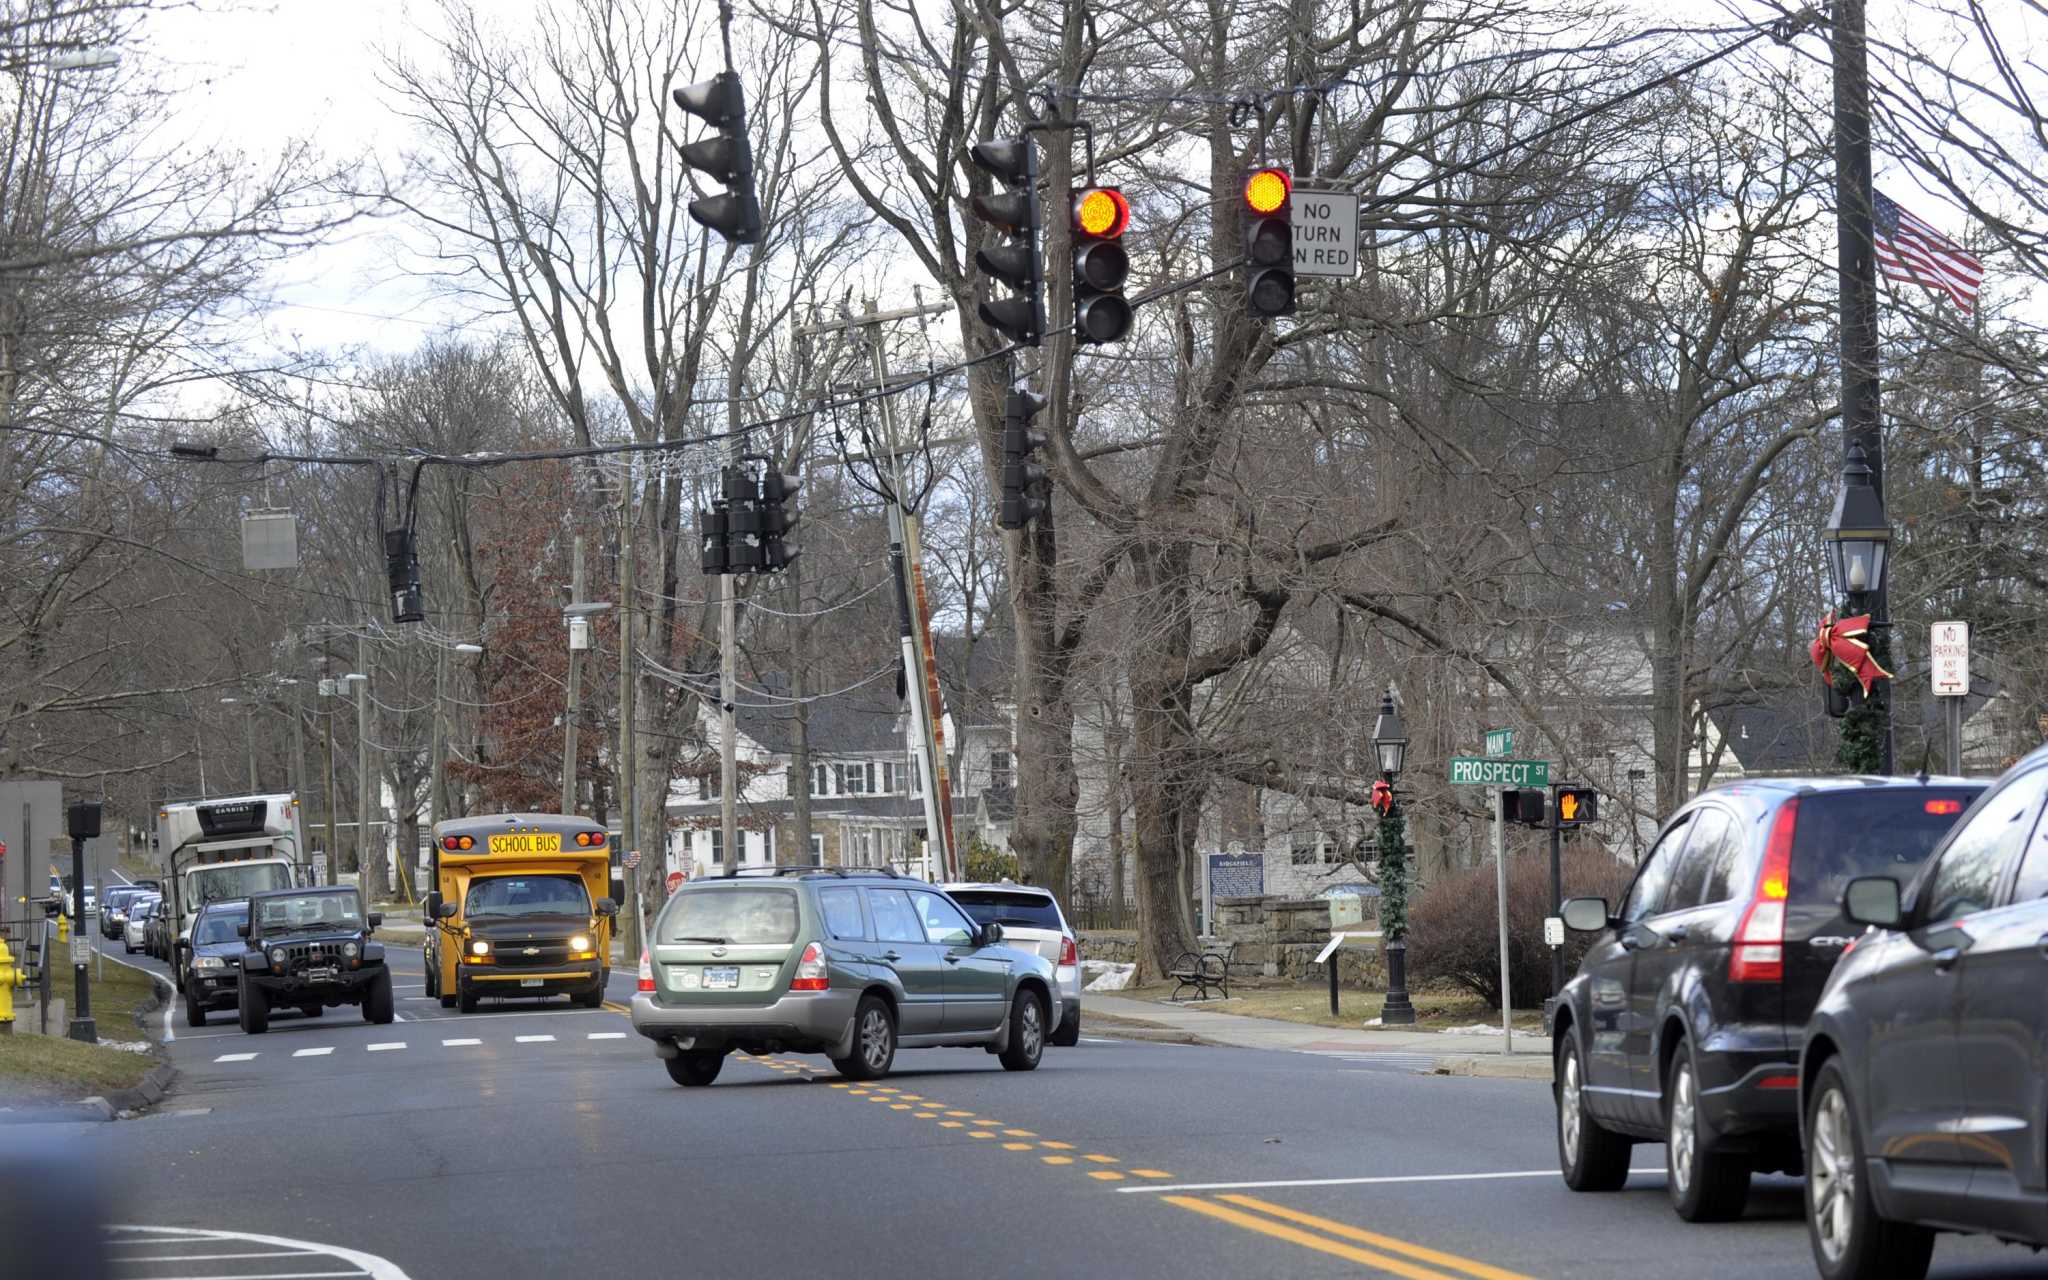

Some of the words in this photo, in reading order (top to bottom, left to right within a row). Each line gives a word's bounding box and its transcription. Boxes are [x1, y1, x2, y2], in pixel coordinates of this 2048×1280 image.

[1304, 203, 1331, 220] NO
[1294, 225, 1341, 242] TURN
[1295, 248, 1307, 264] N
[1314, 249, 1349, 265] RED
[1943, 629, 1956, 642] NO
[1934, 644, 1967, 658] PARKING
[1943, 660, 1956, 668] ANY
[1943, 670, 1957, 679] TIME
[1486, 734, 1504, 755] MAIN
[1505, 732, 1512, 743] ST
[1454, 761, 1530, 784] PROSPECT
[1535, 765, 1545, 776] ST
[492, 836, 534, 853] SCHOOL
[536, 835, 558, 852] BUS
